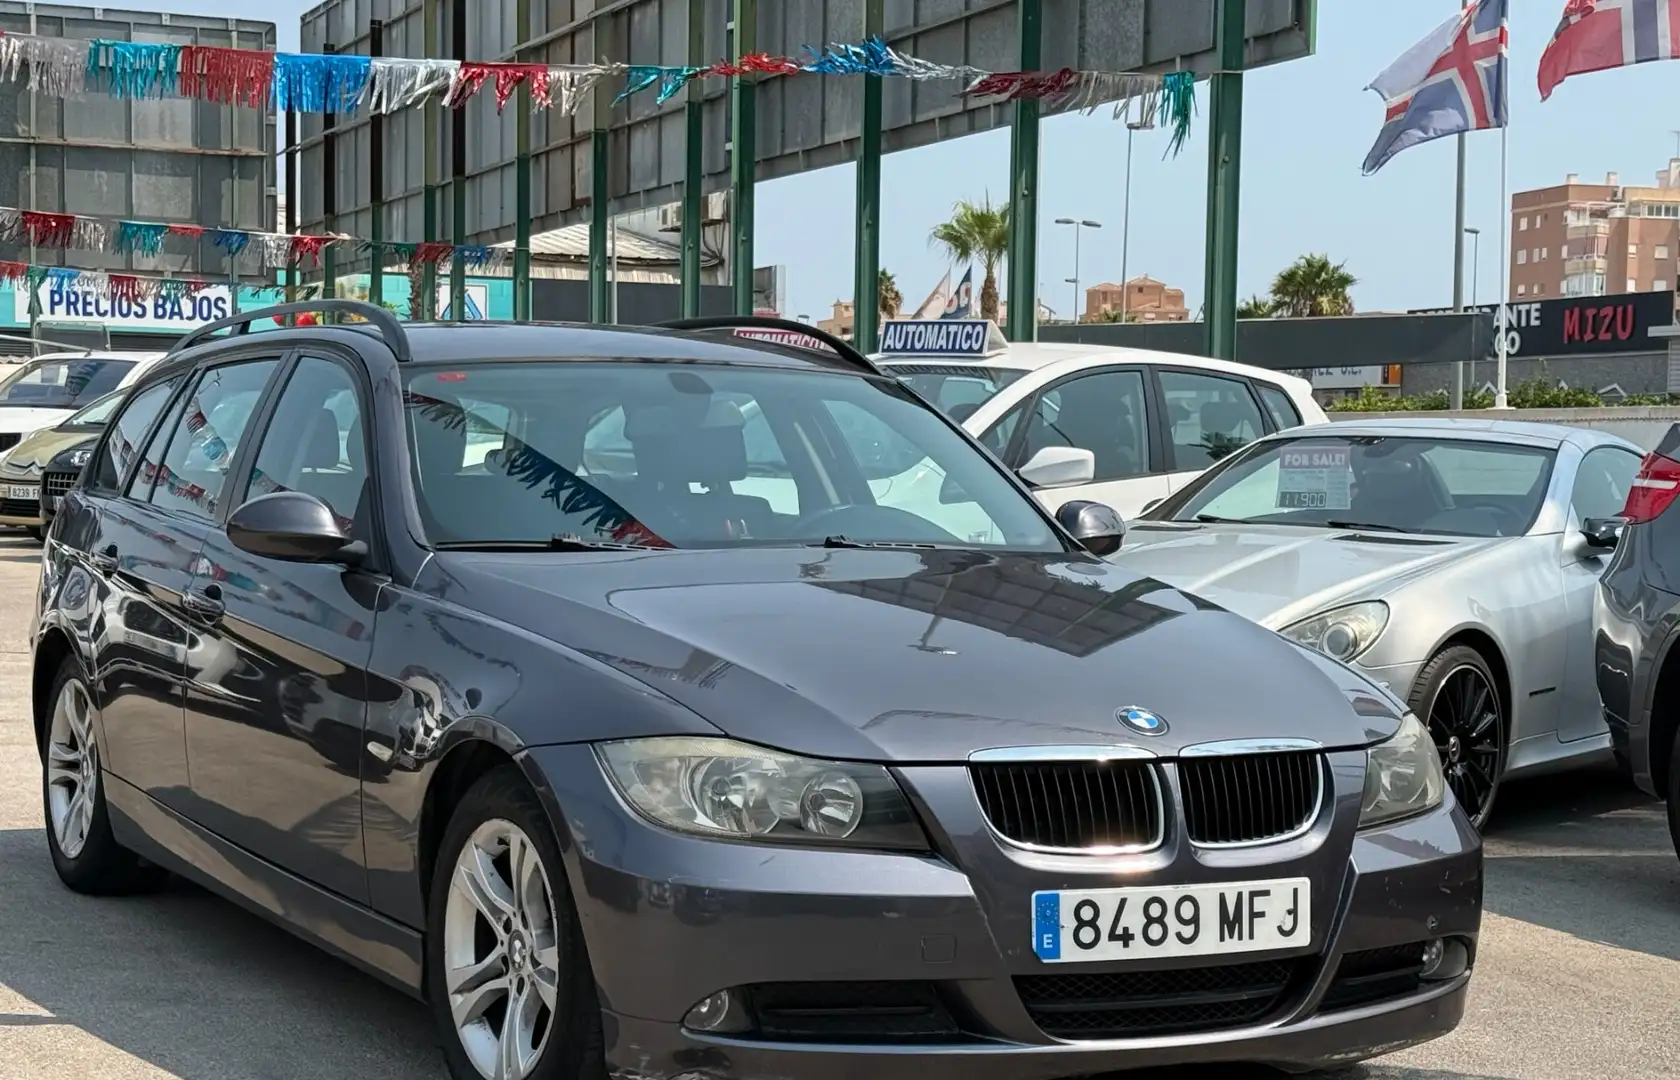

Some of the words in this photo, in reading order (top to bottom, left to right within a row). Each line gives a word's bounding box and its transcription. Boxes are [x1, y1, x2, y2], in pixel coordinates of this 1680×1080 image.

[50, 289, 147, 319] PRECIOS
[153, 294, 227, 322] BAJOS
[883, 324, 984, 351] AUTOMATICO
[1563, 304, 1635, 345] MIZU
[1284, 453, 1310, 467] FOR
[1284, 493, 1326, 507] 11900
[1072, 894, 1201, 950] 8489
[1218, 887, 1299, 943] MFJ
[1042, 933, 1054, 949] E
